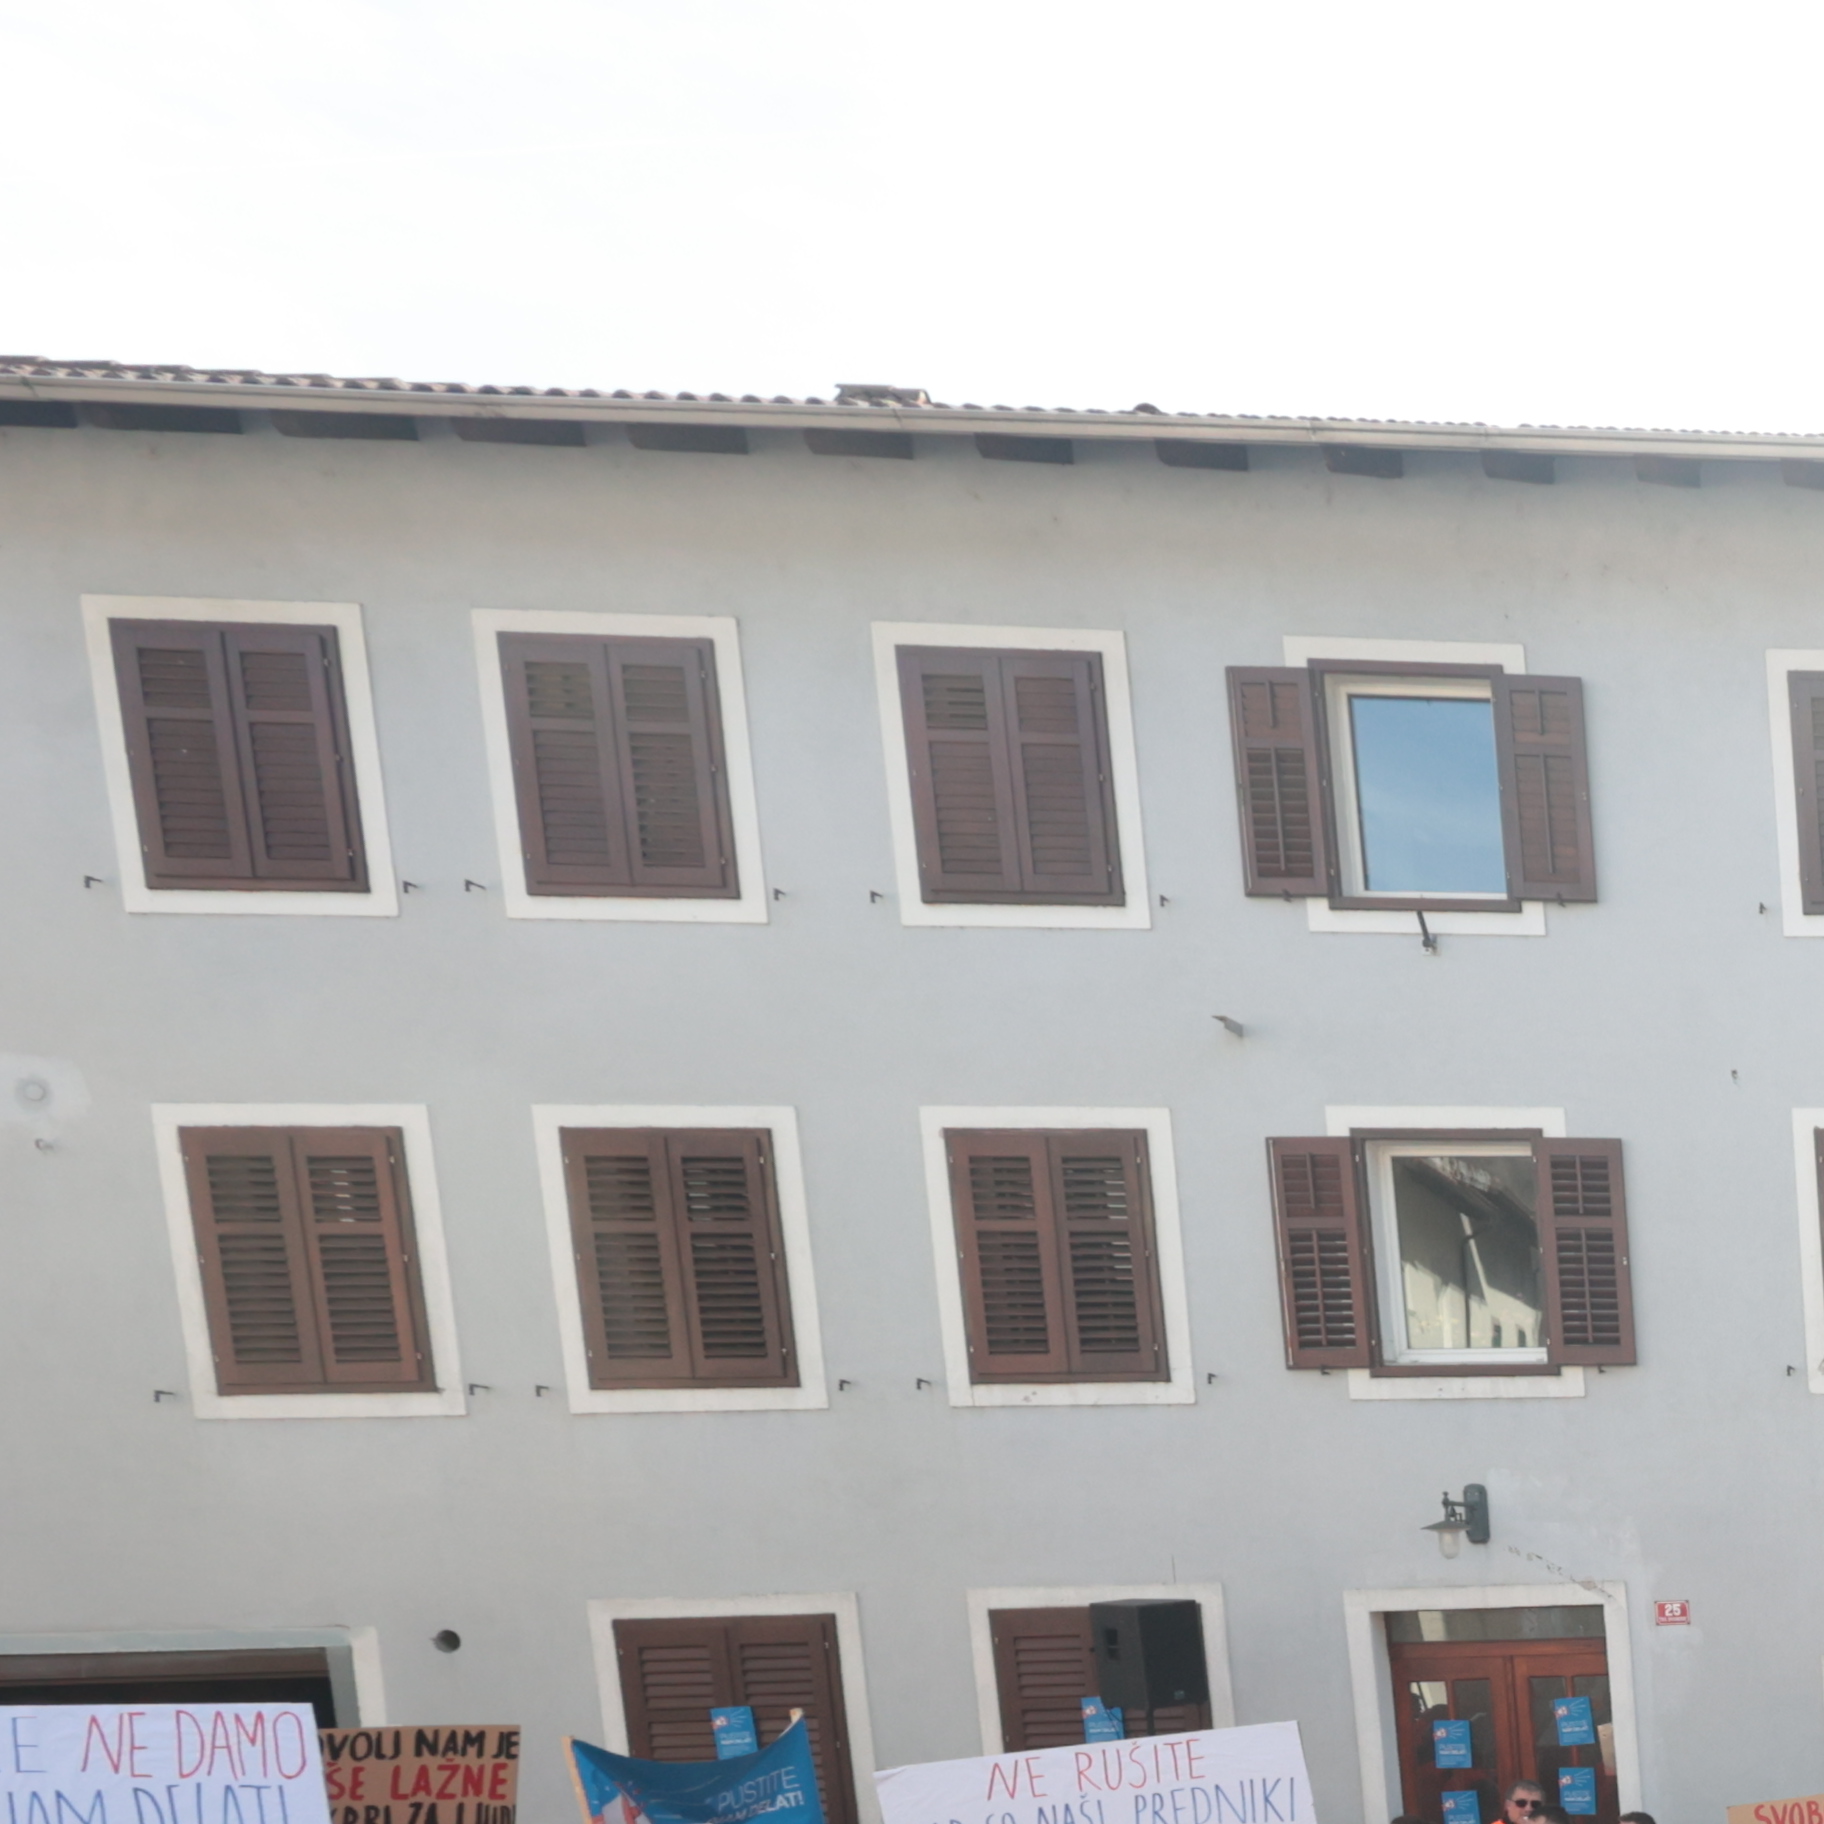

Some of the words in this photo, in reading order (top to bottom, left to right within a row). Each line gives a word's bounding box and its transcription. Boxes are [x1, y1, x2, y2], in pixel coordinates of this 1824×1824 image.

[1664, 1603, 1682, 1617] 25
[81, 1711, 153, 1778] NE
[175, 1709, 307, 1780] DAMO
[414, 1729, 486, 1758] NAM
[491, 1731, 520, 1759] JE
[389, 1758, 509, 1800] LAŽNE
[717, 1765, 800, 1814] PUSTITE
[987, 1756, 1048, 1801] NE
[1074, 1739, 1206, 1792] RUŠITE
